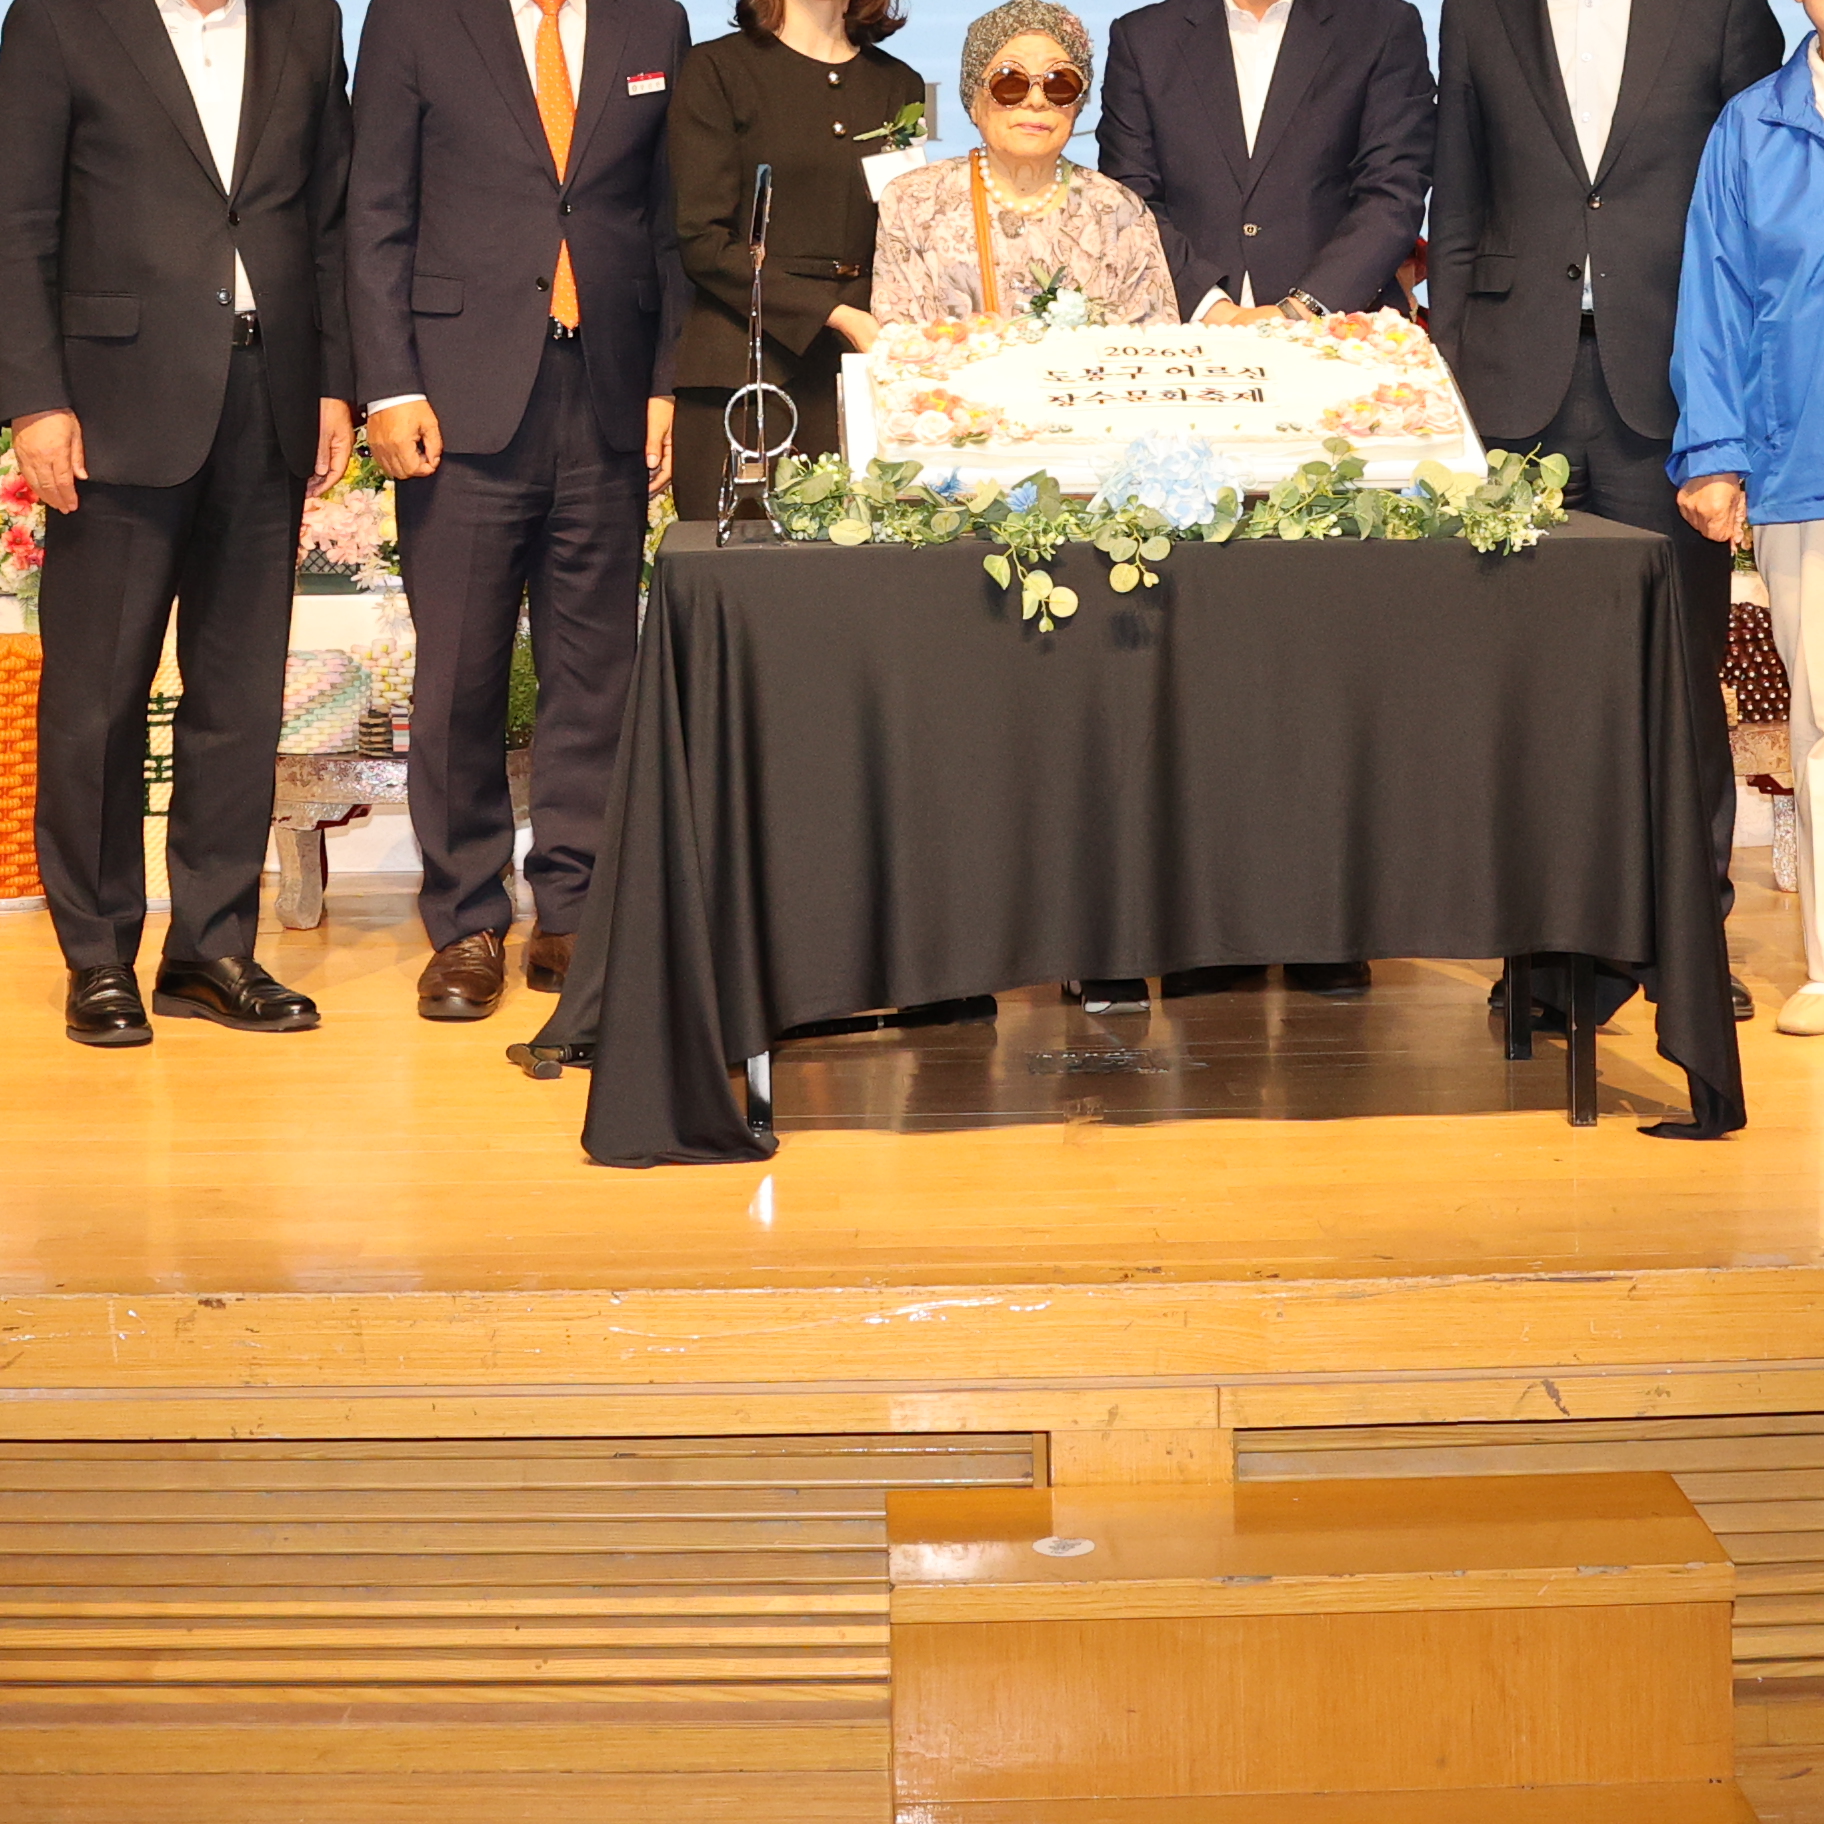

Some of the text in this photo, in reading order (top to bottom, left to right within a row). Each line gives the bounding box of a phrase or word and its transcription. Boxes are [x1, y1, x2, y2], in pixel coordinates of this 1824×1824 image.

[1103, 344, 1205, 358] 2026년
[1042, 364, 1271, 382] 도봉구 어르신
